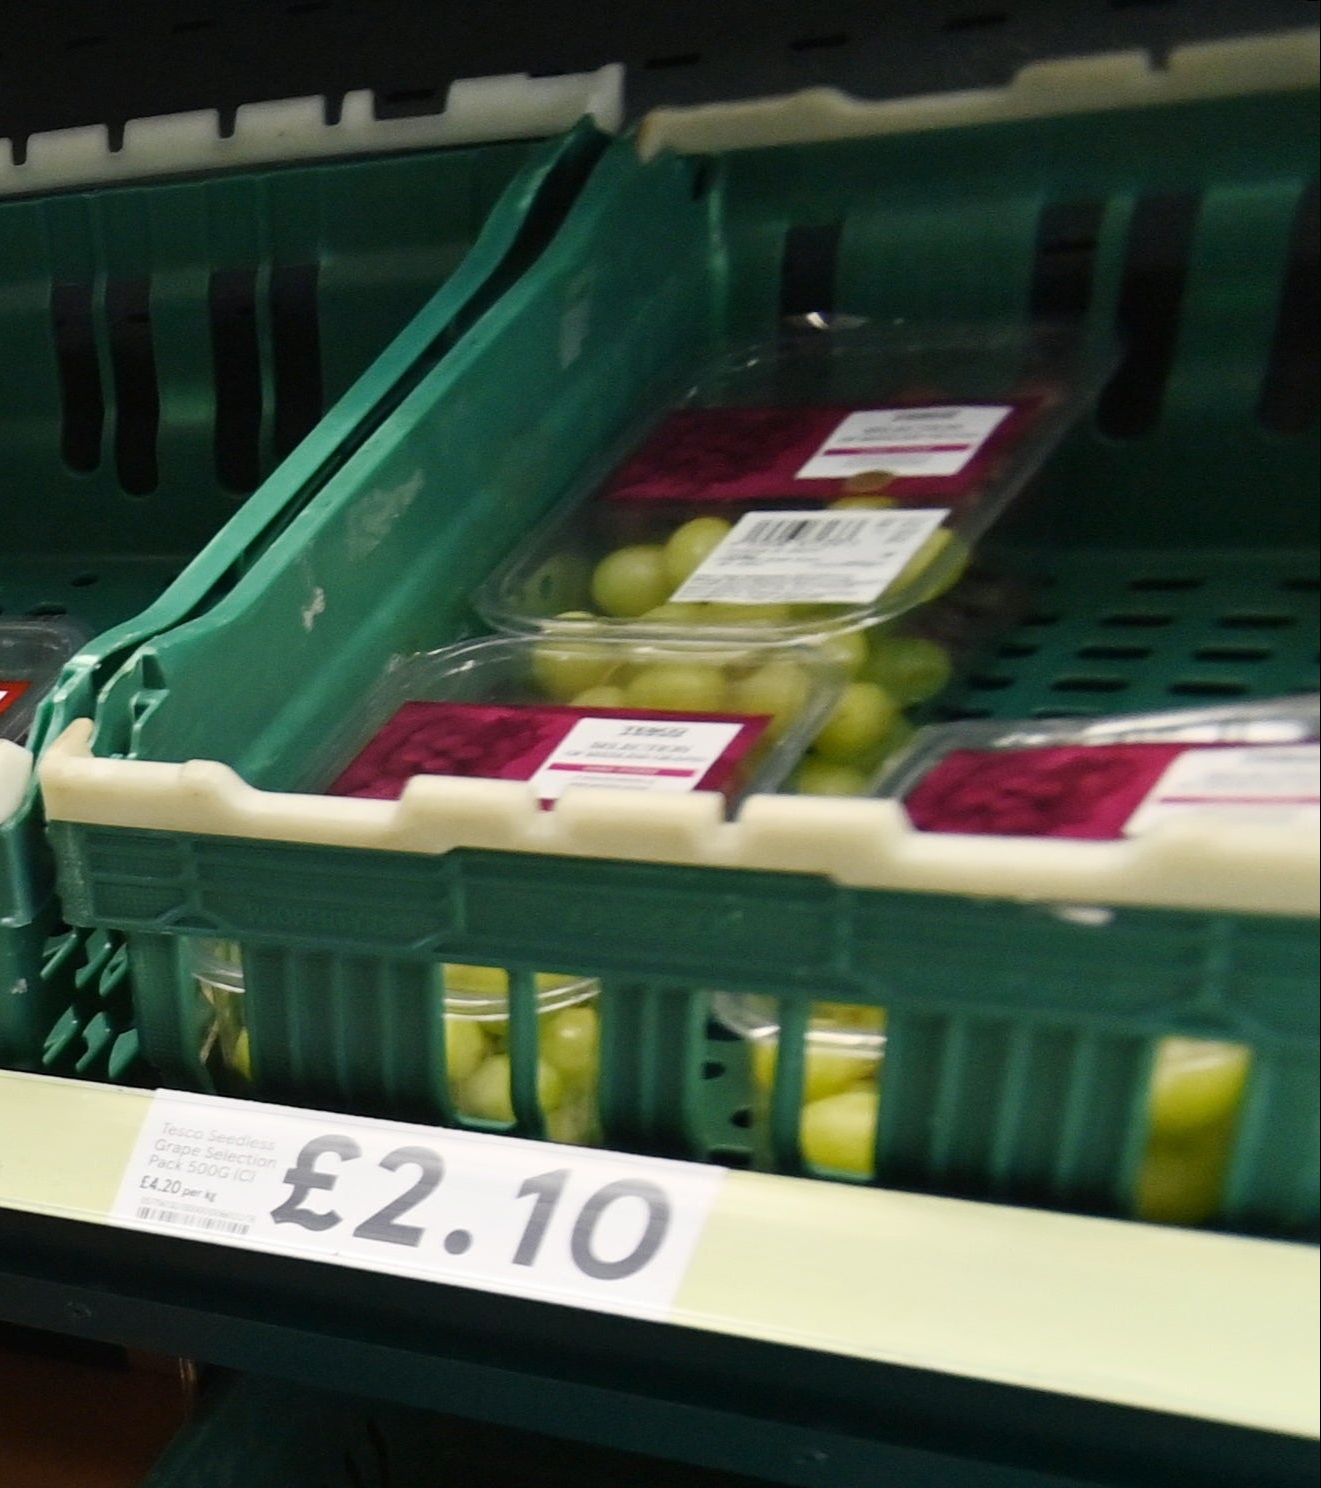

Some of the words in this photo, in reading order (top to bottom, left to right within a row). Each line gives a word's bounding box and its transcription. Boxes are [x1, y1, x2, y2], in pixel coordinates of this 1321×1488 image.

[162, 1121, 204, 1139] Tesco
[207, 1128, 276, 1151] Seedless
[148, 1154, 183, 1171] Pack
[187, 1160, 230, 1179] 500G
[154, 1138, 201, 1157] Grape
[205, 1146, 278, 1168] Selection
[139, 1175, 182, 1195] £4.20
[181, 1187, 202, 1198] per
[268, 1133, 674, 1283] £2.10
